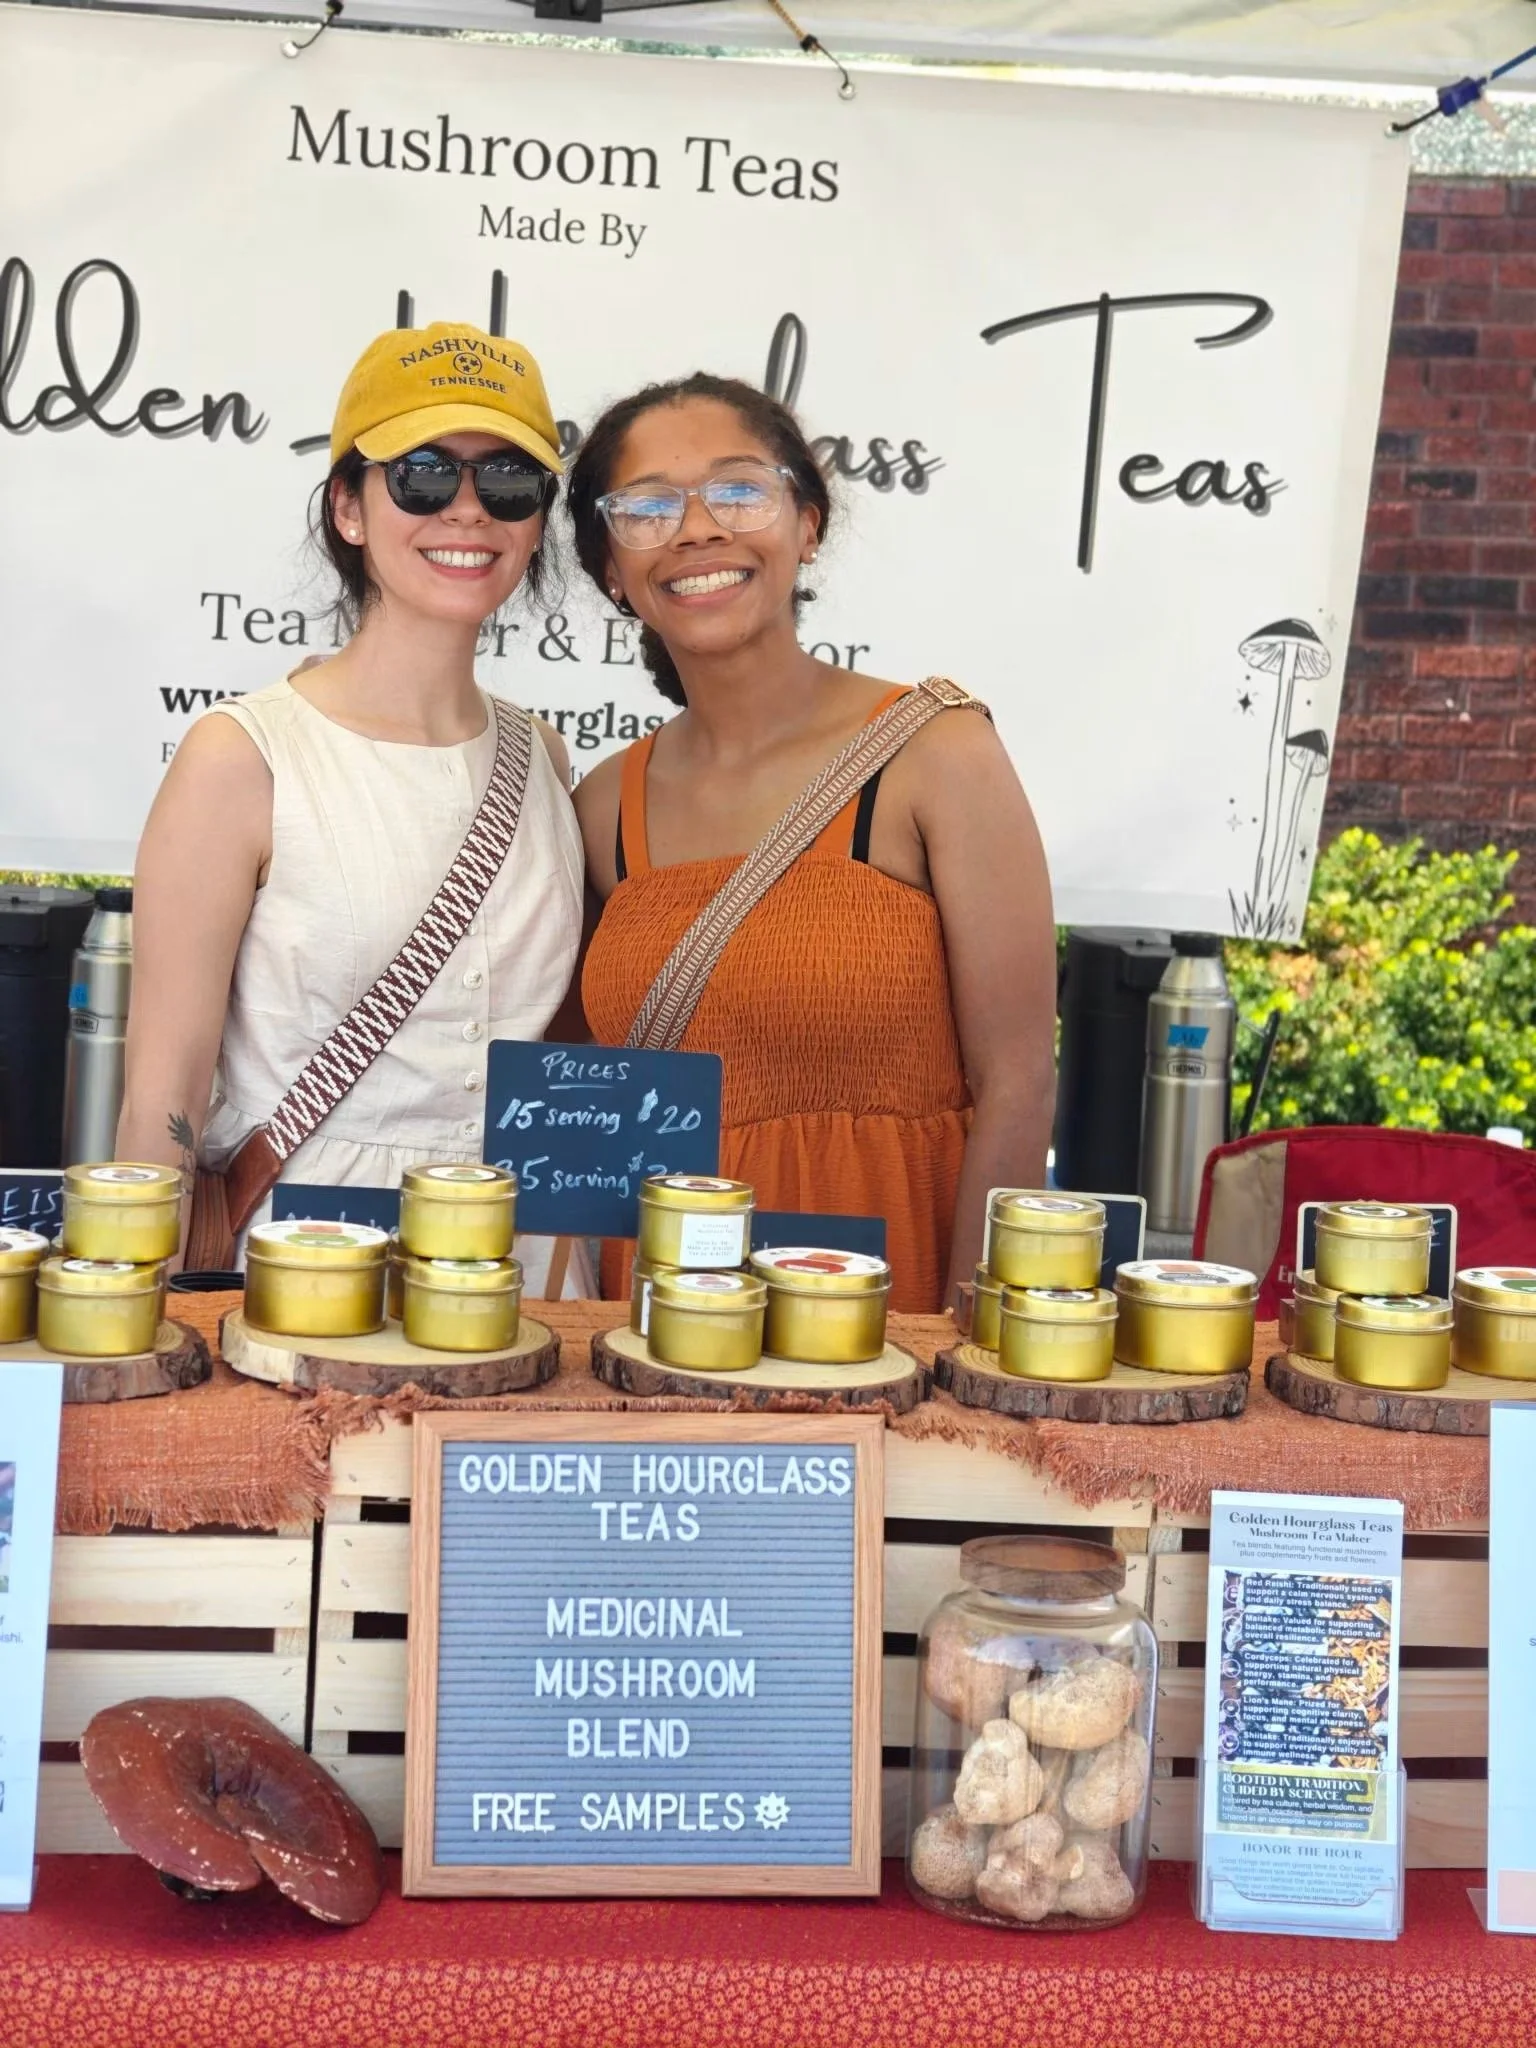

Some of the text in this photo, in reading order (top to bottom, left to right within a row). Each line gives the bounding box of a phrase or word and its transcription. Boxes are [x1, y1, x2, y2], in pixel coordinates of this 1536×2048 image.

[286, 104, 840, 203] Mushroom Teas
[478, 203, 647, 259] Made By
[399, 338, 526, 377] NASHVILLE
[430, 376, 508, 394] TENNESSEE
[980, 292, 1289, 575] Teas
[201, 592, 308, 646] Tea
[538, 613, 581, 665] &
[497, 1098, 546, 1130] 15
[544, 1105, 621, 1135] serving
[550, 1166, 630, 1199] serving
[459, 1454, 853, 1497] GOLDEN HOURGLASS
[591, 1501, 701, 1542] TEAS
[1284, 1516, 1356, 1532] Hourglass
[1360, 1520, 1393, 1532] Teas
[1250, 1528, 1372, 1543] Mushroom Tea Maker
[1246, 1578, 1262, 1586] Red
[1297, 1582, 1350, 1592] Traditionally
[1246, 1588, 1278, 1596] support
[1311, 1592, 1344, 1600] nervous
[1346, 1594, 1376, 1602] system
[1264, 1597, 1284, 1606] daily
[1314, 1600, 1350, 1608] balance.
[546, 1597, 743, 1639] MEDICINAL
[1283, 1616, 1312, 1624] Valued
[1328, 1620, 1374, 1630] supporting
[1246, 1623, 1382, 1638] balanced metabolic function and
[1244, 1662, 1290, 1672] supporting
[1324, 1666, 1360, 1675] physical
[1294, 1656, 1340, 1664] Celebrated
[1342, 1658, 1354, 1666] for
[534, 1657, 756, 1700] MUSHROOM
[1316, 1674, 1331, 1682] and
[1244, 1696, 1269, 1704] Lion's
[1299, 1700, 1326, 1708] Prized
[1244, 1705, 1288, 1716] supporting
[1291, 1708, 1330, 1718] cognitive
[1272, 1714, 1286, 1722] and
[1290, 1716, 1318, 1724] mental
[1320, 1718, 1366, 1728] sharpness.
[567, 1718, 690, 1758] BLEND
[1283, 1734, 1336, 1745] Traditionally
[1338, 1738, 1371, 1746] enjoyed
[1244, 1748, 1317, 1760] immune wellness.
[1254, 1742, 1287, 1750] support
[1289, 1744, 1326, 1753] everyday
[1329, 1746, 1358, 1756] vitality
[1223, 1773, 1364, 1792] ROOTED IN TRADITION.
[1222, 1784, 1342, 1800] GUIDED BY SCIENCE.
[1252, 1798, 1261, 1806] by
[1303, 1801, 1326, 1809] herbal
[472, 1792, 745, 1834] FREE SAMPLES
[1243, 1842, 1362, 1859] HONOR THE HOUR
